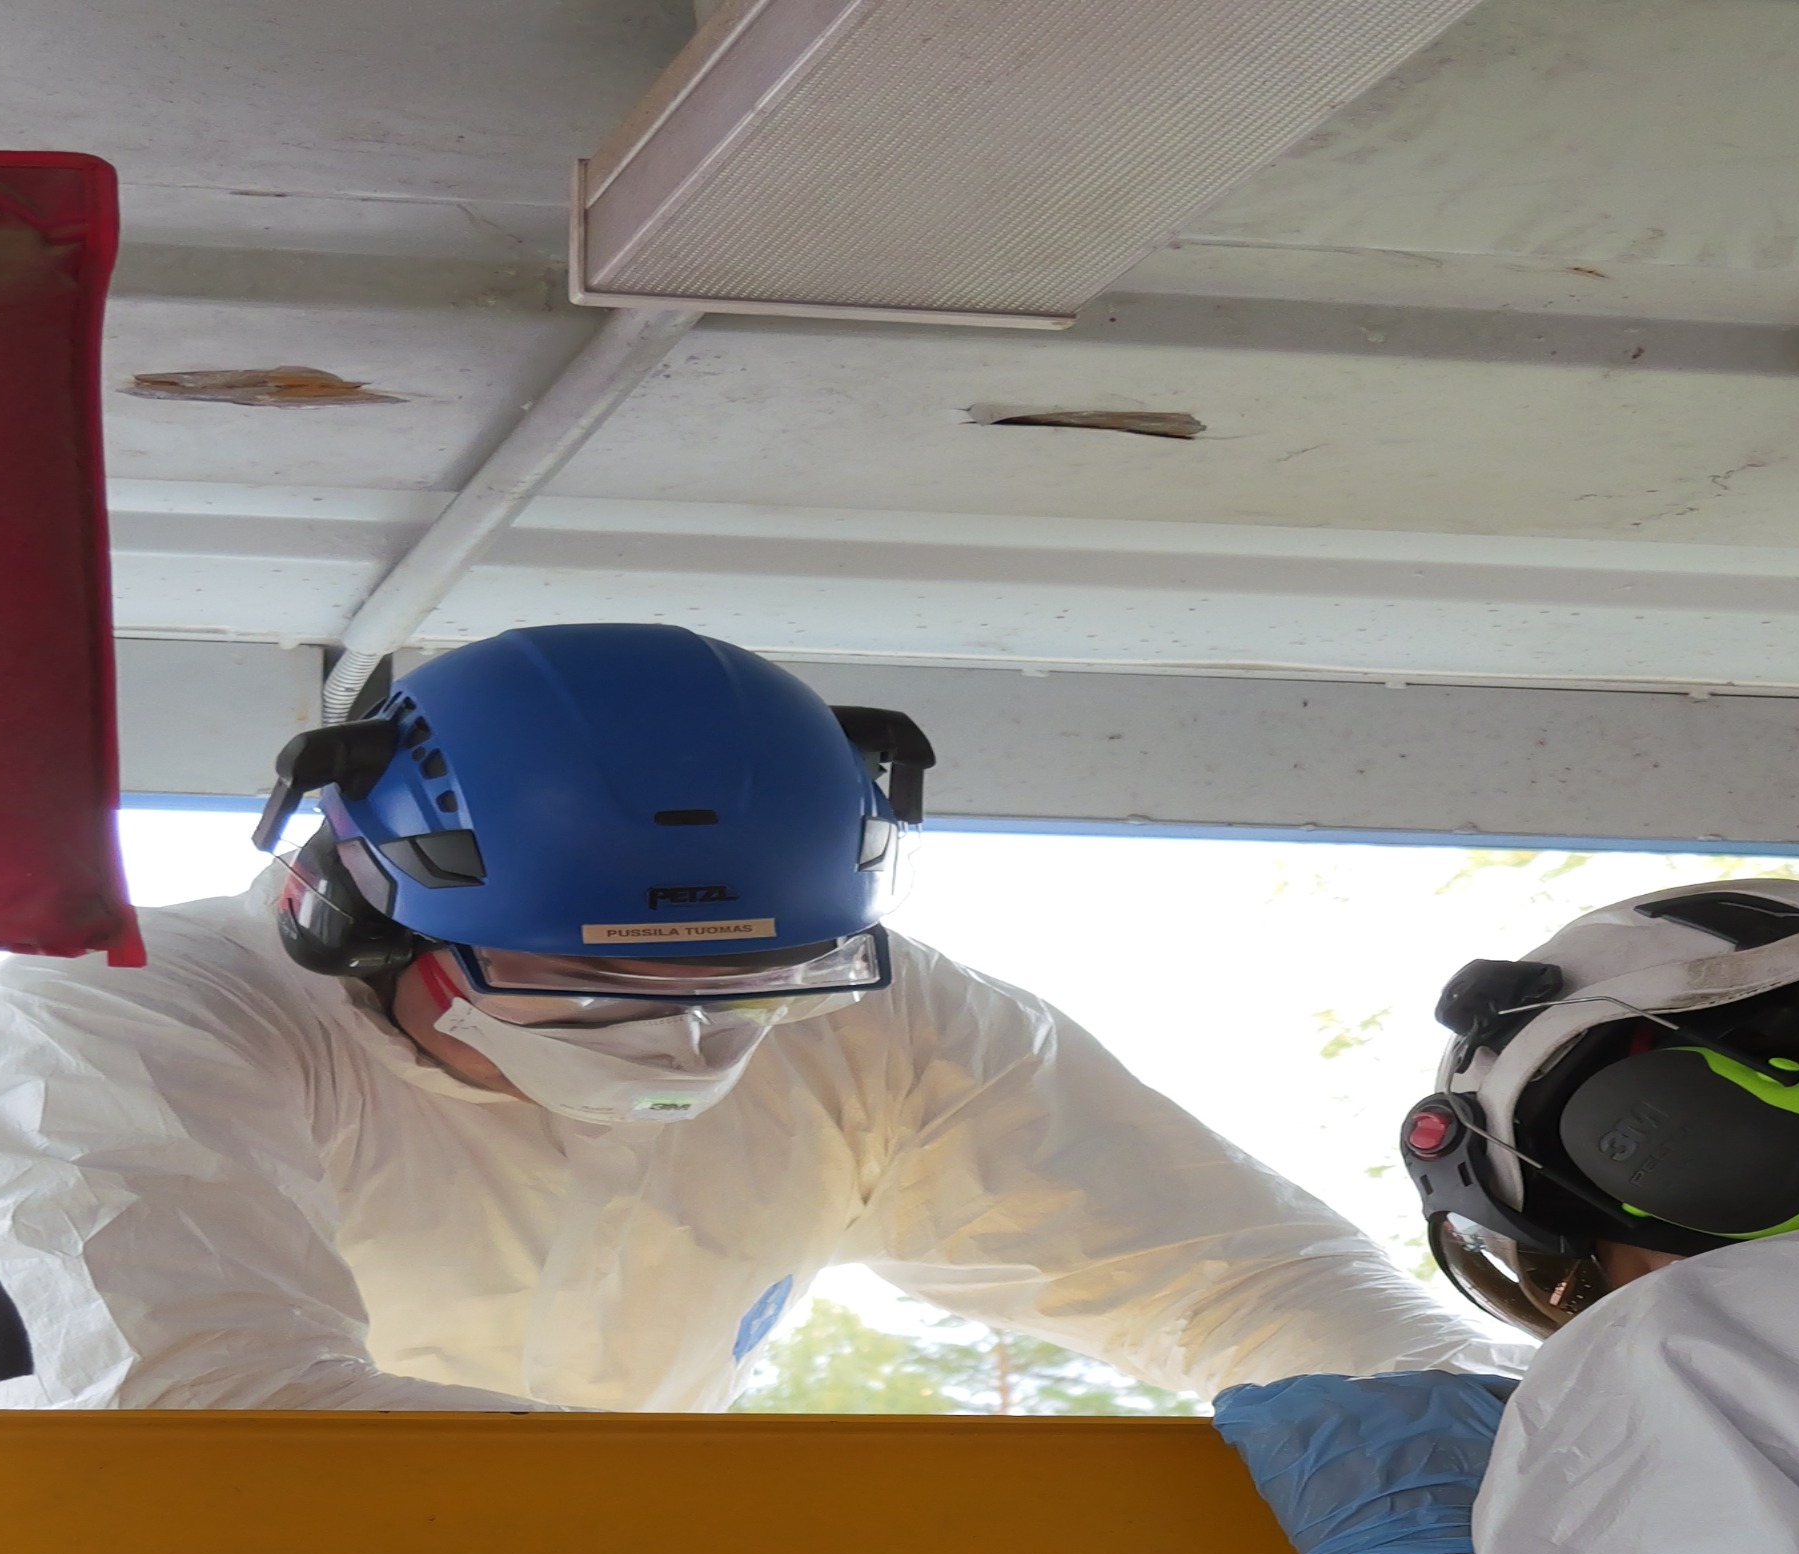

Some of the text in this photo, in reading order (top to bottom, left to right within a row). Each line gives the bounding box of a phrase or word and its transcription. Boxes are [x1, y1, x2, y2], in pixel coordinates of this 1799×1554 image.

[647, 885, 741, 911] PETZL
[606, 924, 753, 938] PUSSILA TUOMAS
[648, 1103, 692, 1112] 3M
[1598, 1099, 1671, 1162] 3M
